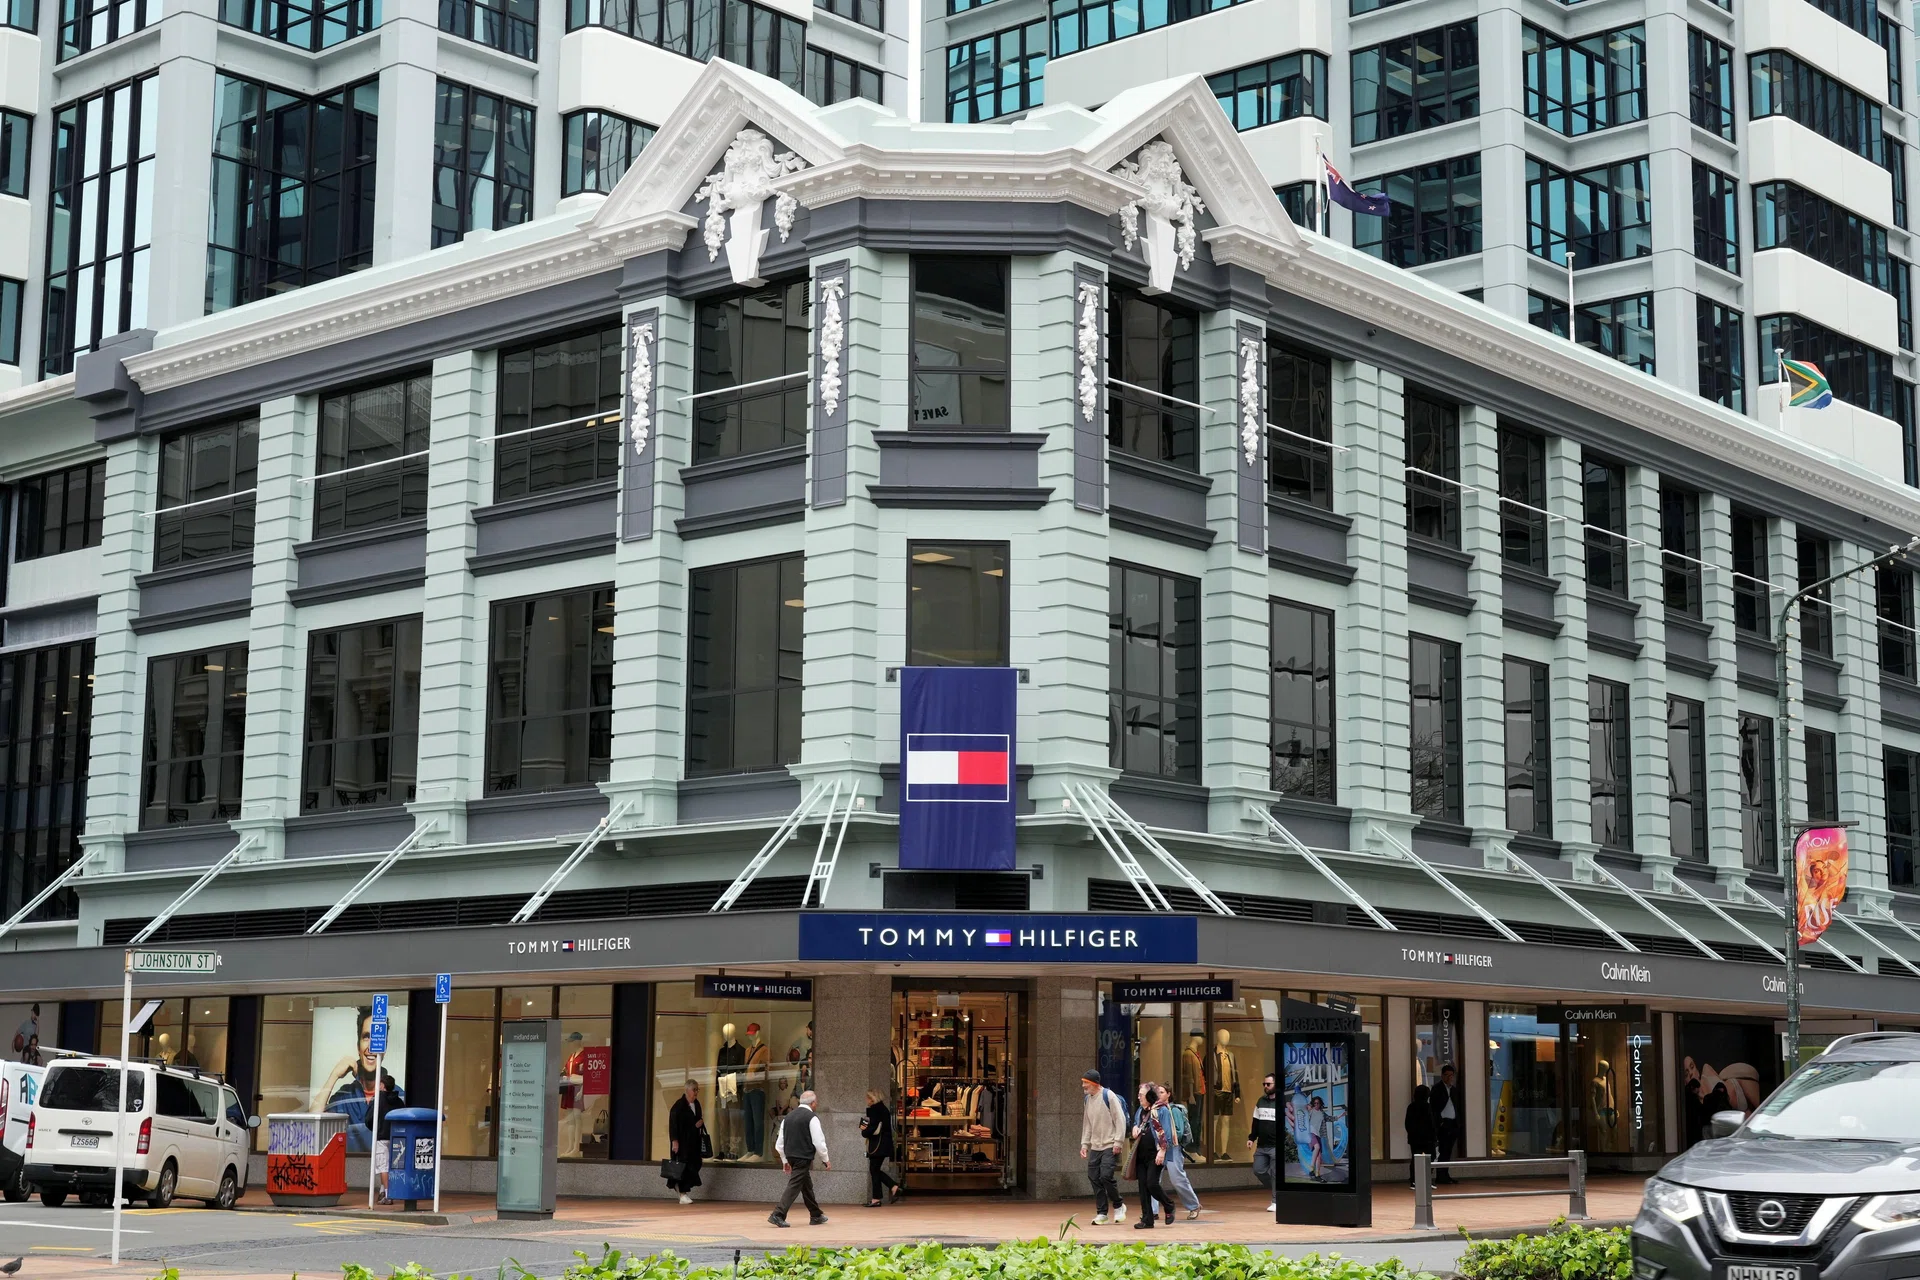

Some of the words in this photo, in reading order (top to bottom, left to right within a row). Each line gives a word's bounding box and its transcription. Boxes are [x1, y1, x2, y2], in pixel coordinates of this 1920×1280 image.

[508, 940, 559, 954] TOMMY
[578, 937, 631, 951] HILFIGER
[858, 928, 977, 946] TOMMY
[1020, 929, 1138, 947] HILFIGER
[140, 953, 192, 968] JOHNSTON
[197, 955, 209, 969] ST
[1401, 948, 1441, 964] TOMMY
[1455, 953, 1493, 967] HILFIGER
[1601, 961, 1630, 981] Calvin
[1630, 964, 1651, 983] Klein
[713, 982, 752, 993] TOMMY
[765, 985, 802, 995] HILFIGER
[1123, 988, 1164, 997] TOMMY
[1179, 986, 1222, 996] HILFIGER
[1762, 975, 1787, 993] Calvin
[1565, 1010, 1594, 1020] Calvin
[1595, 1009, 1617, 1020] Klein
[1286, 1017, 1328, 1031] URBAN
[1333, 1017, 1357, 1031] ART
[1443, 1008, 1451, 1054] Denim
[530, 1033, 539, 1041] park
[1289, 1047, 1328, 1064] DRINK
[1332, 1047, 1342, 1064] IT
[1633, 1035, 1642, 1087] Calvin
[587, 1060, 606, 1070] 50%
[1303, 1065, 1325, 1083] ALL
[1327, 1064, 1341, 1083] IN
[591, 1071, 602, 1079] OFF
[1635, 1090, 1643, 1129] Klein
